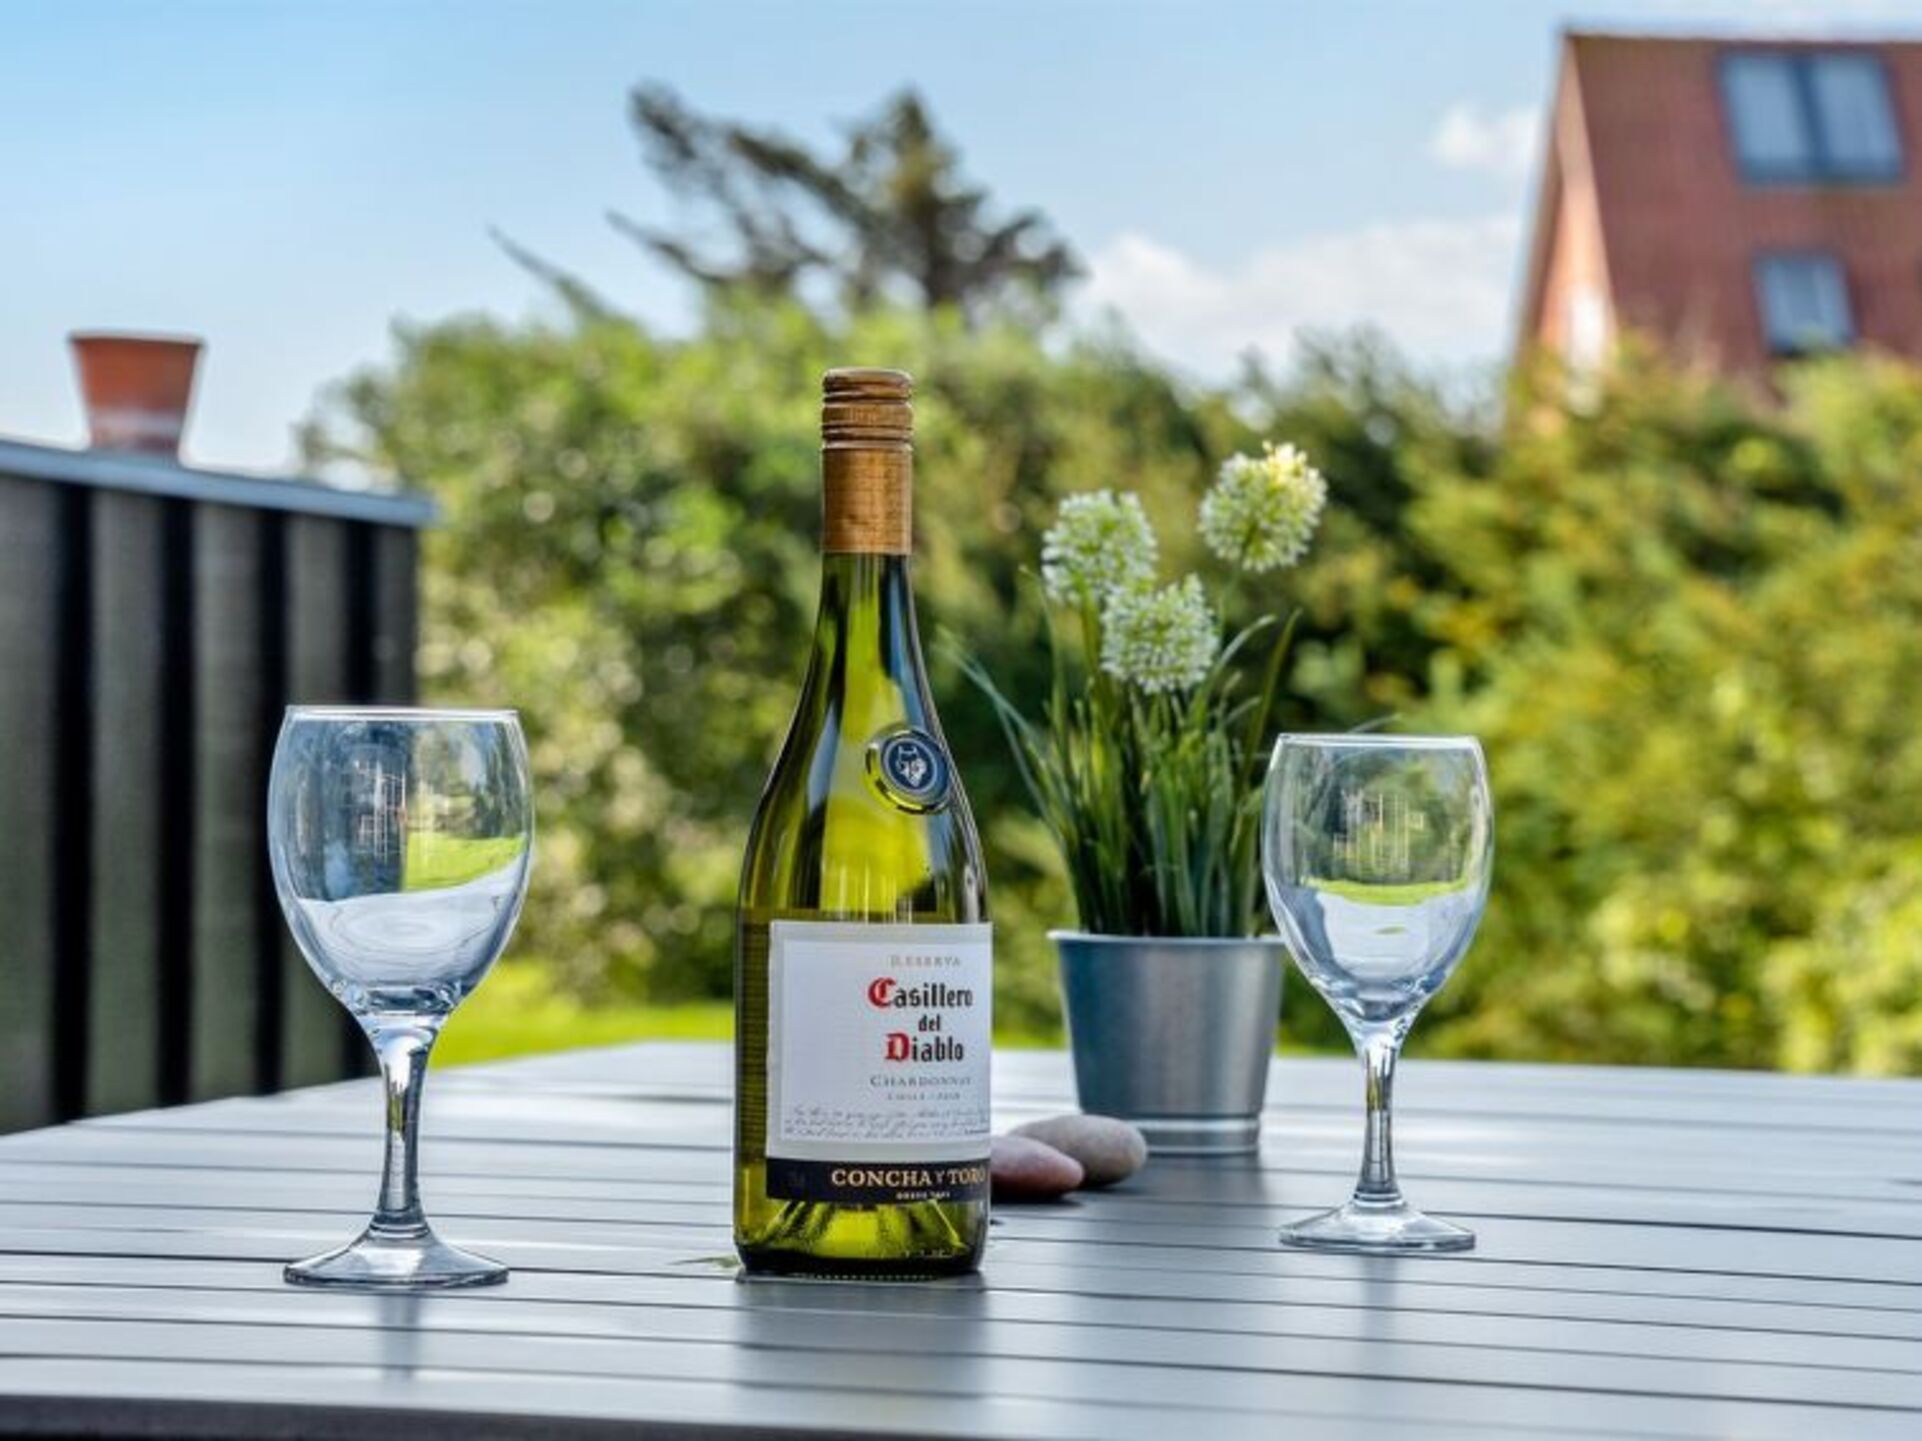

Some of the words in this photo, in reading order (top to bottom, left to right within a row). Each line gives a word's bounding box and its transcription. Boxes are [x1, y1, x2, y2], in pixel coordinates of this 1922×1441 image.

[868, 977, 974, 1008] Casillero
[918, 1014, 941, 1032] del
[885, 1033, 964, 1061] Diablo
[831, 1169, 932, 1187] CONCHA
